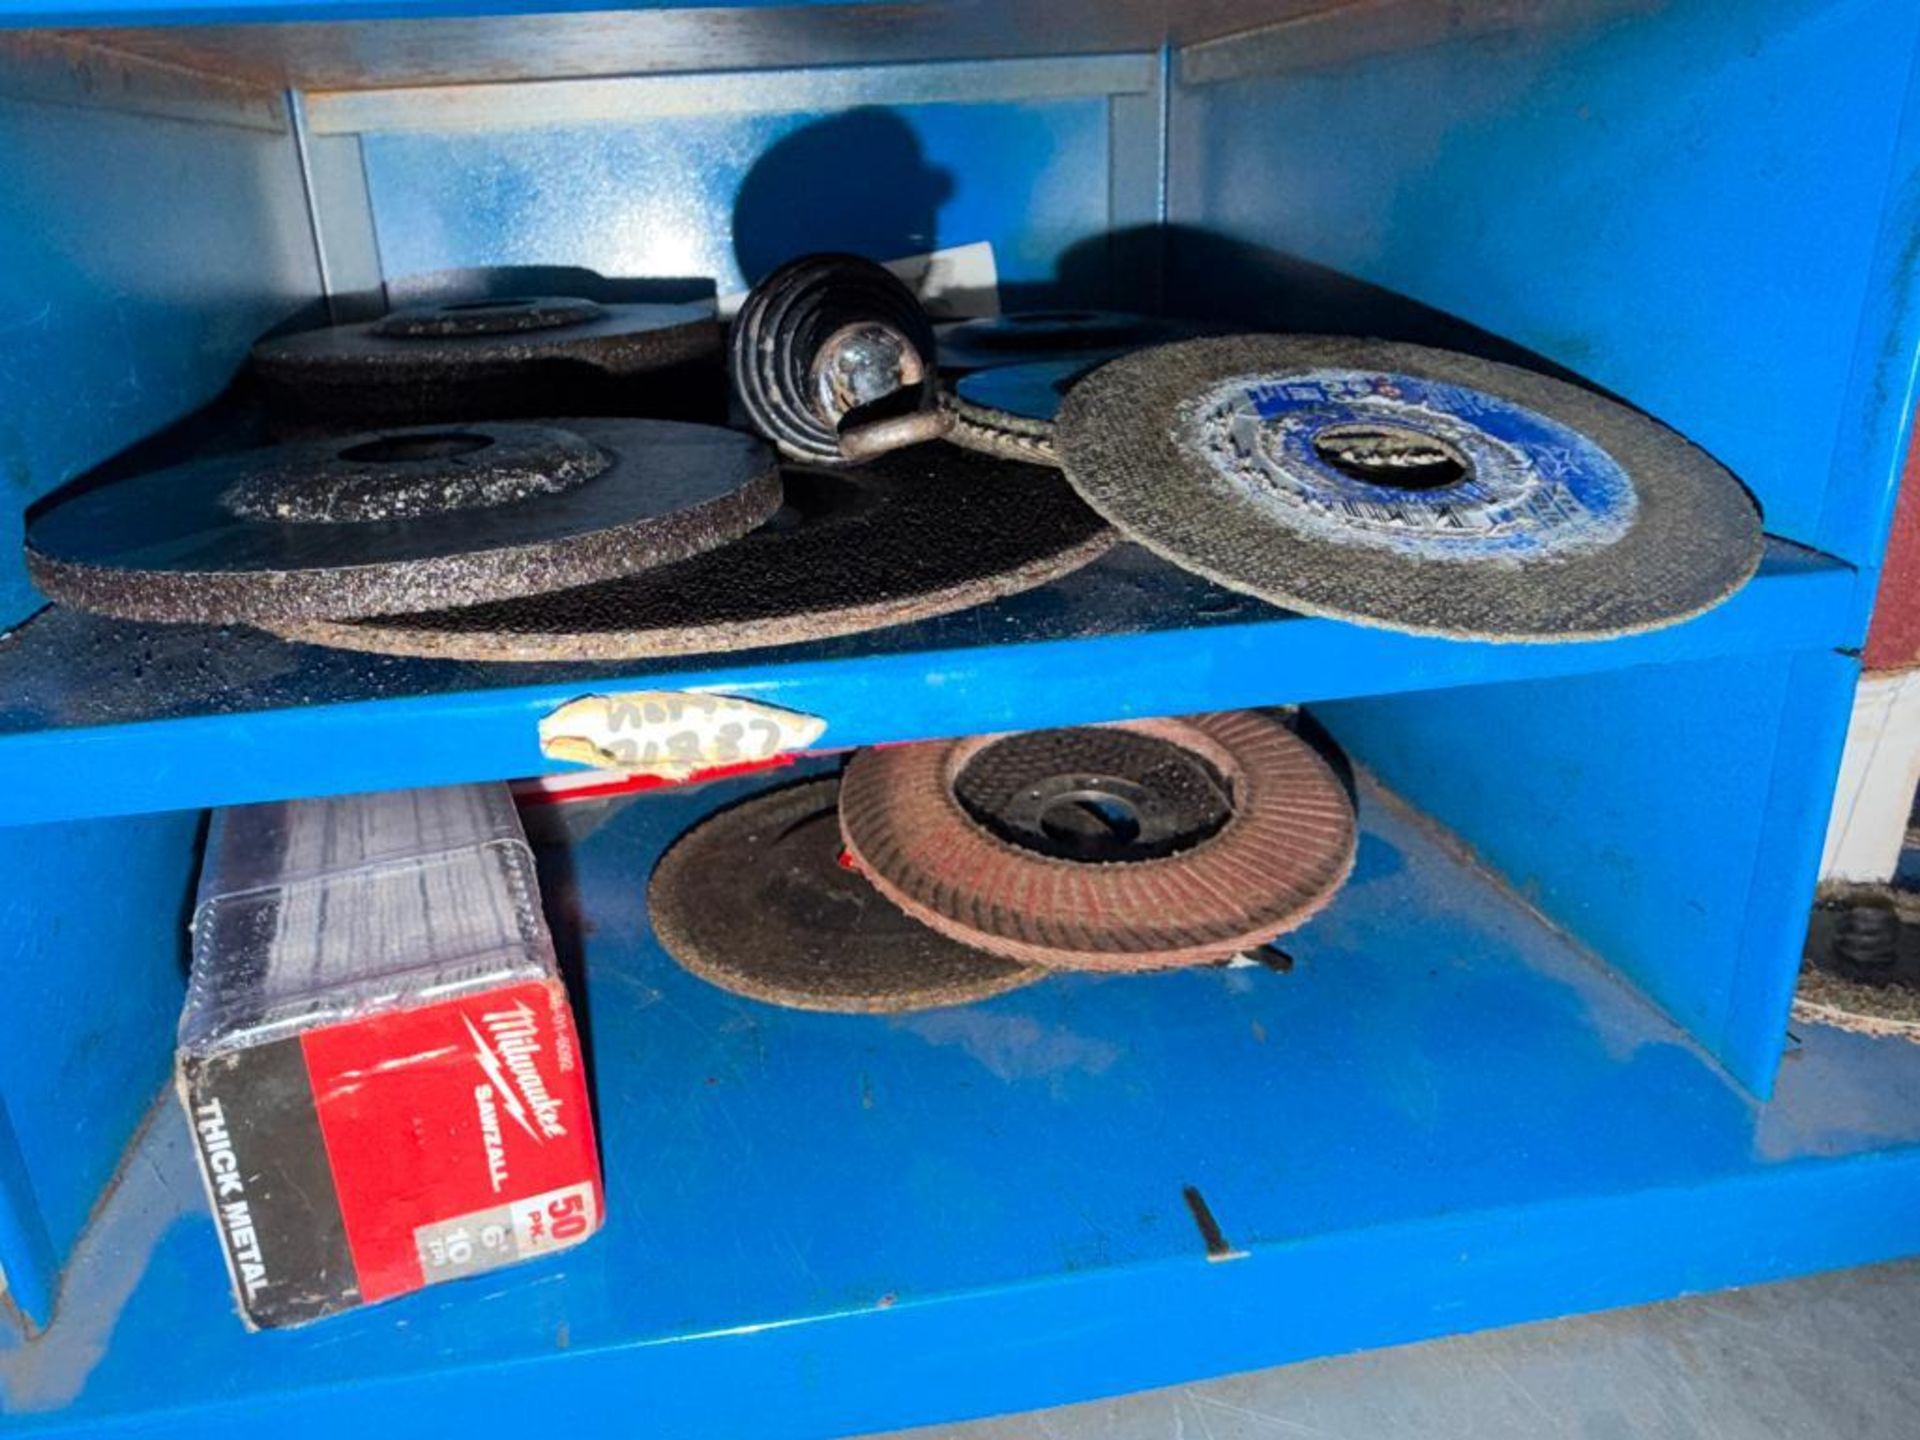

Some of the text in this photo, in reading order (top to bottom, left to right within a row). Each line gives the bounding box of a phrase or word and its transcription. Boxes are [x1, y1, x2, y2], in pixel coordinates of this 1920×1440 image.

[482, 997, 567, 1139] Milwaukee
[474, 1083, 509, 1193] SAWZALL
[197, 1097, 269, 1301] THICK METAL
[548, 1194, 587, 1240] 50
[427, 1236, 447, 1267] TPI
[445, 1226, 473, 1265] 10
